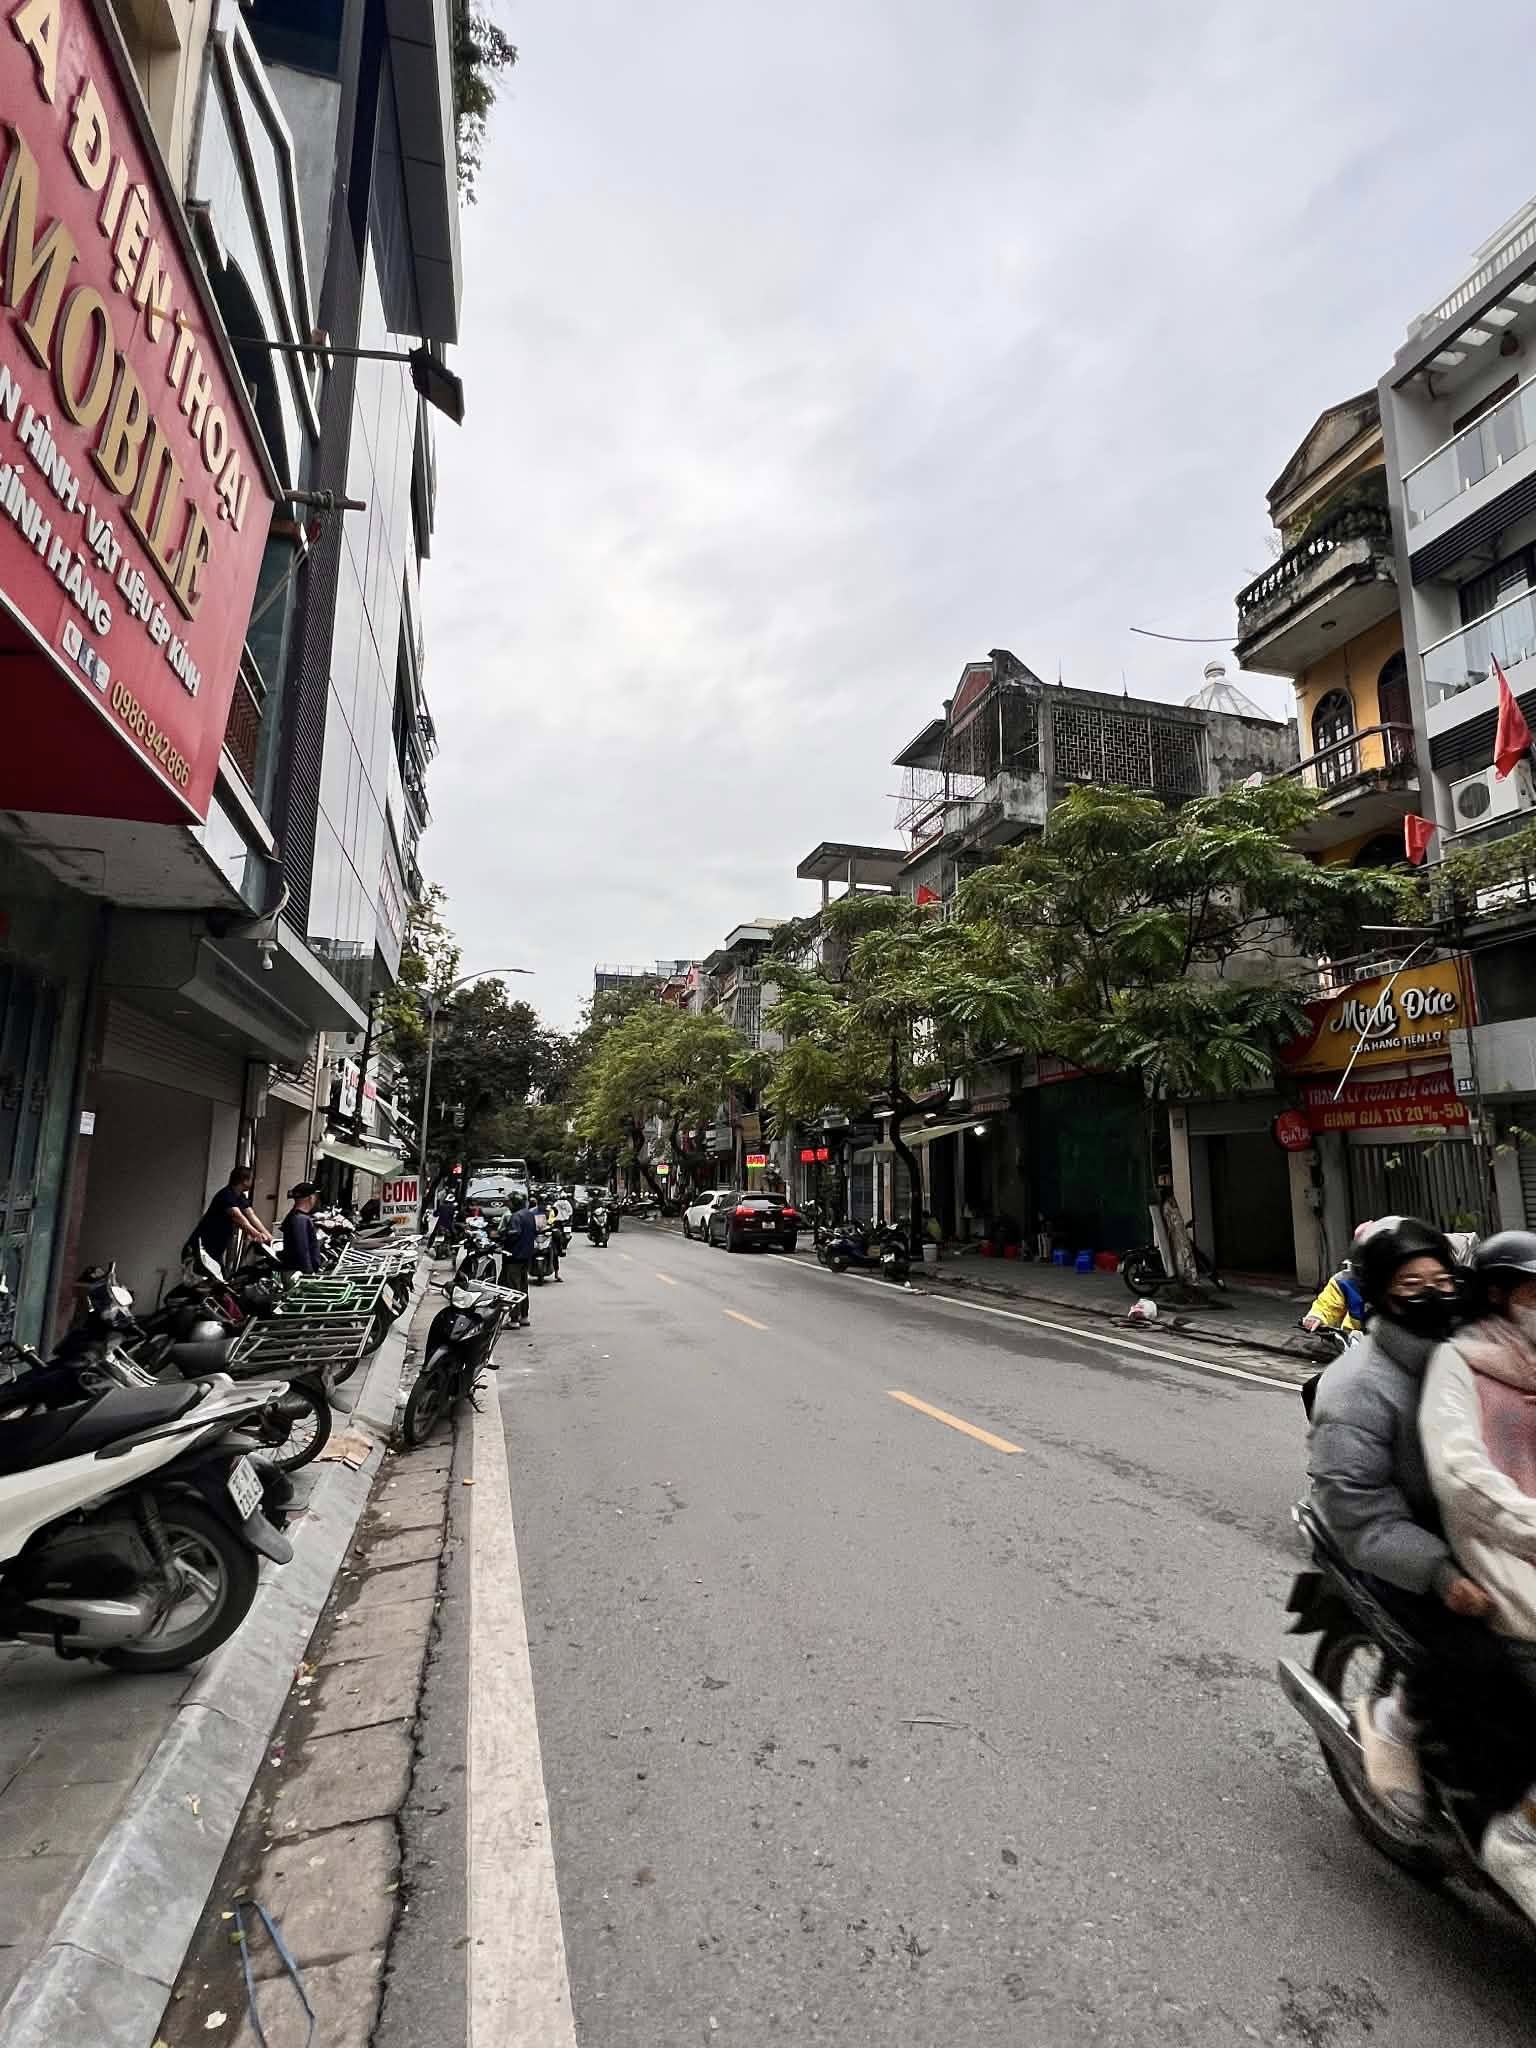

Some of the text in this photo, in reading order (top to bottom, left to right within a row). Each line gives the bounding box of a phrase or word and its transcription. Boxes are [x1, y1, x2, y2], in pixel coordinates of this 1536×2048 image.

[168, 308, 250, 532] THOẠI
[86, 503, 122, 575] VẬT
[117, 558, 154, 622] LIỆU
[148, 602, 171, 645] ÉP
[166, 635, 201, 697] KÍNH
[1330, 986, 1456, 1038] Minh Đức
